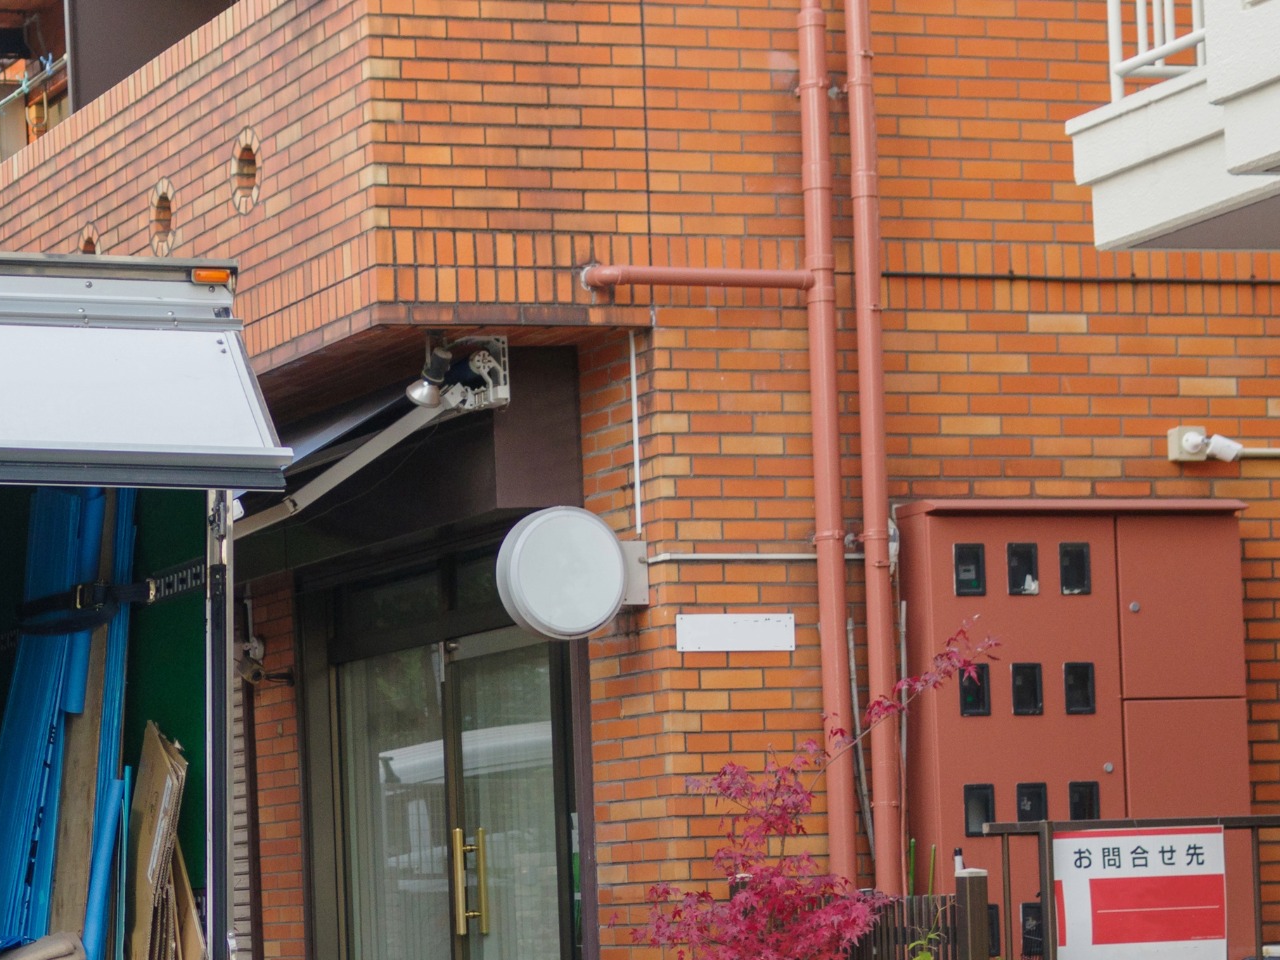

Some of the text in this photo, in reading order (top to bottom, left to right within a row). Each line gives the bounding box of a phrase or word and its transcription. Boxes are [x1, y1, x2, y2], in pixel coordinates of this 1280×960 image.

[1073, 844, 1205, 869] お問合せ先
